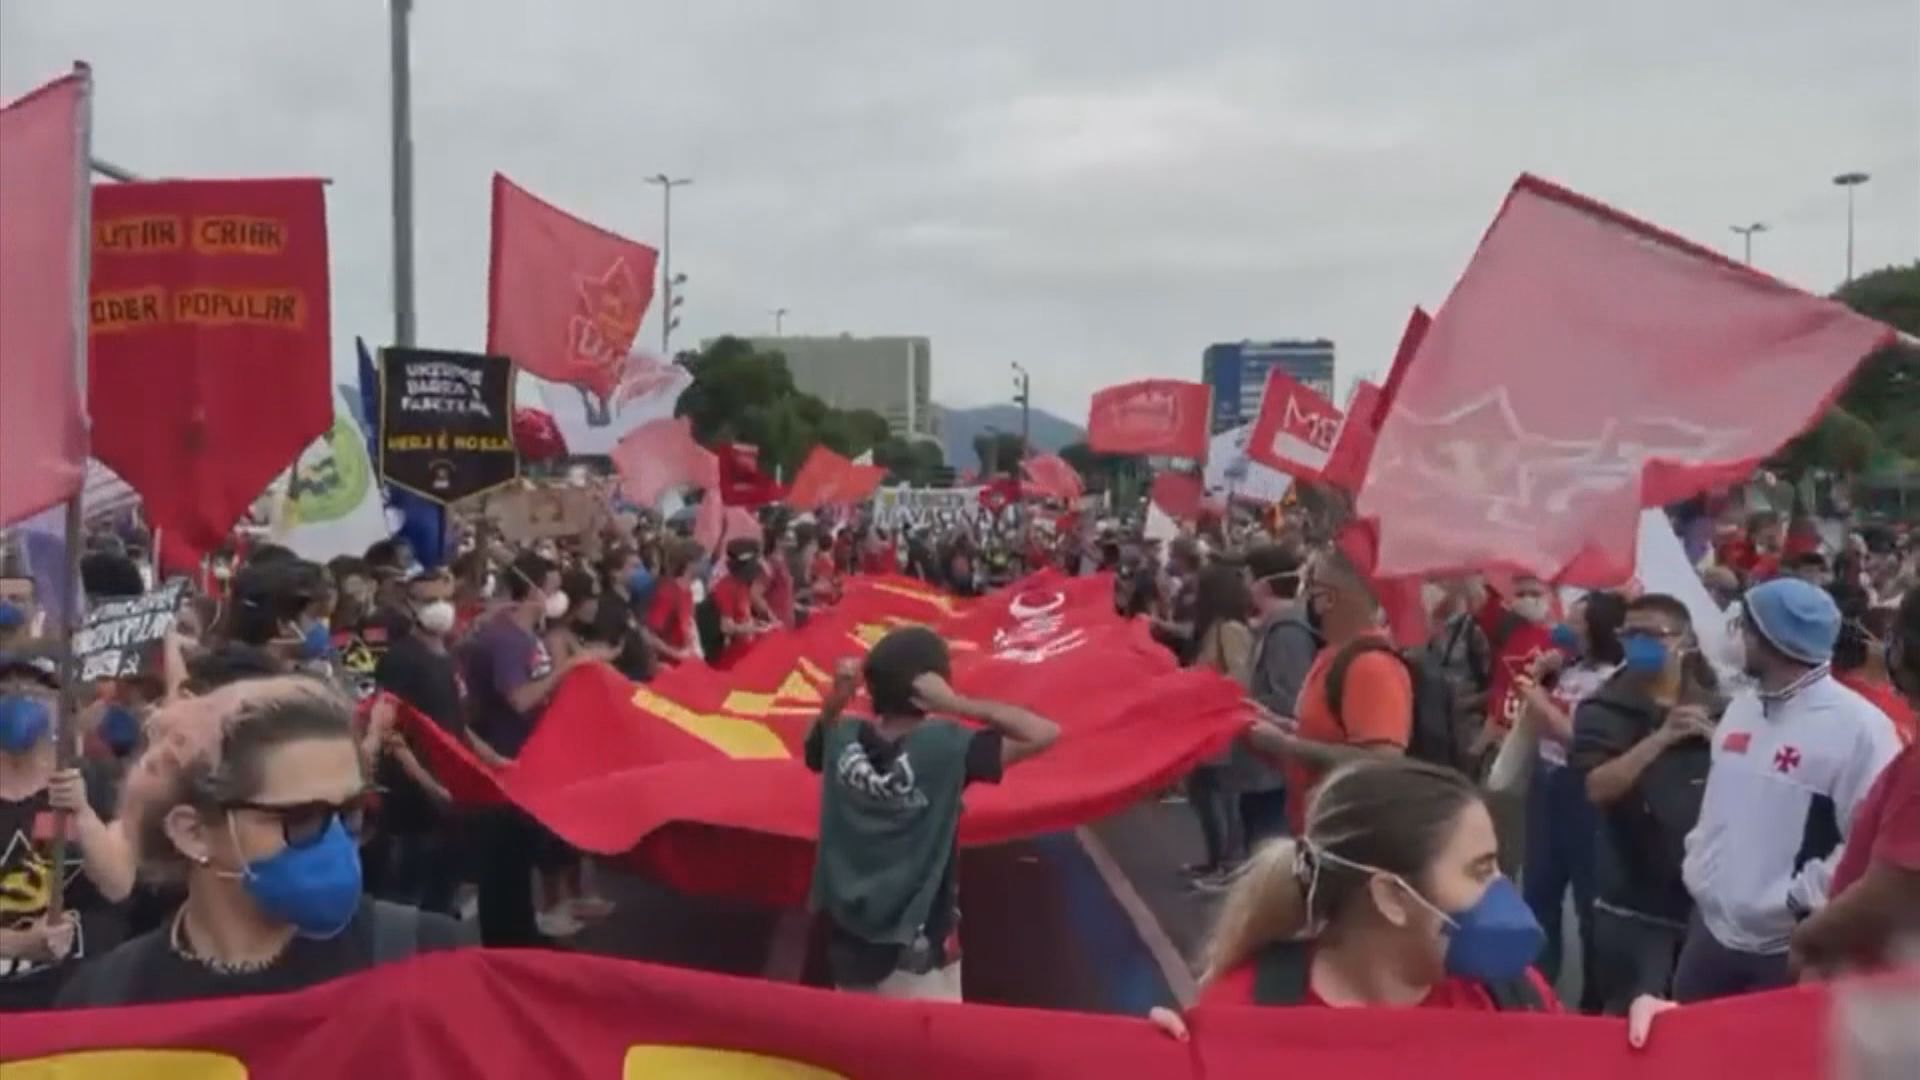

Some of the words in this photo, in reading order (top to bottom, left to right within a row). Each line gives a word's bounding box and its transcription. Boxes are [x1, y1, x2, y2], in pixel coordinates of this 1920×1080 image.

[98, 221, 176, 249] UTAR
[91, 294, 159, 324] ODER
[178, 294, 295, 321] POPULAR
